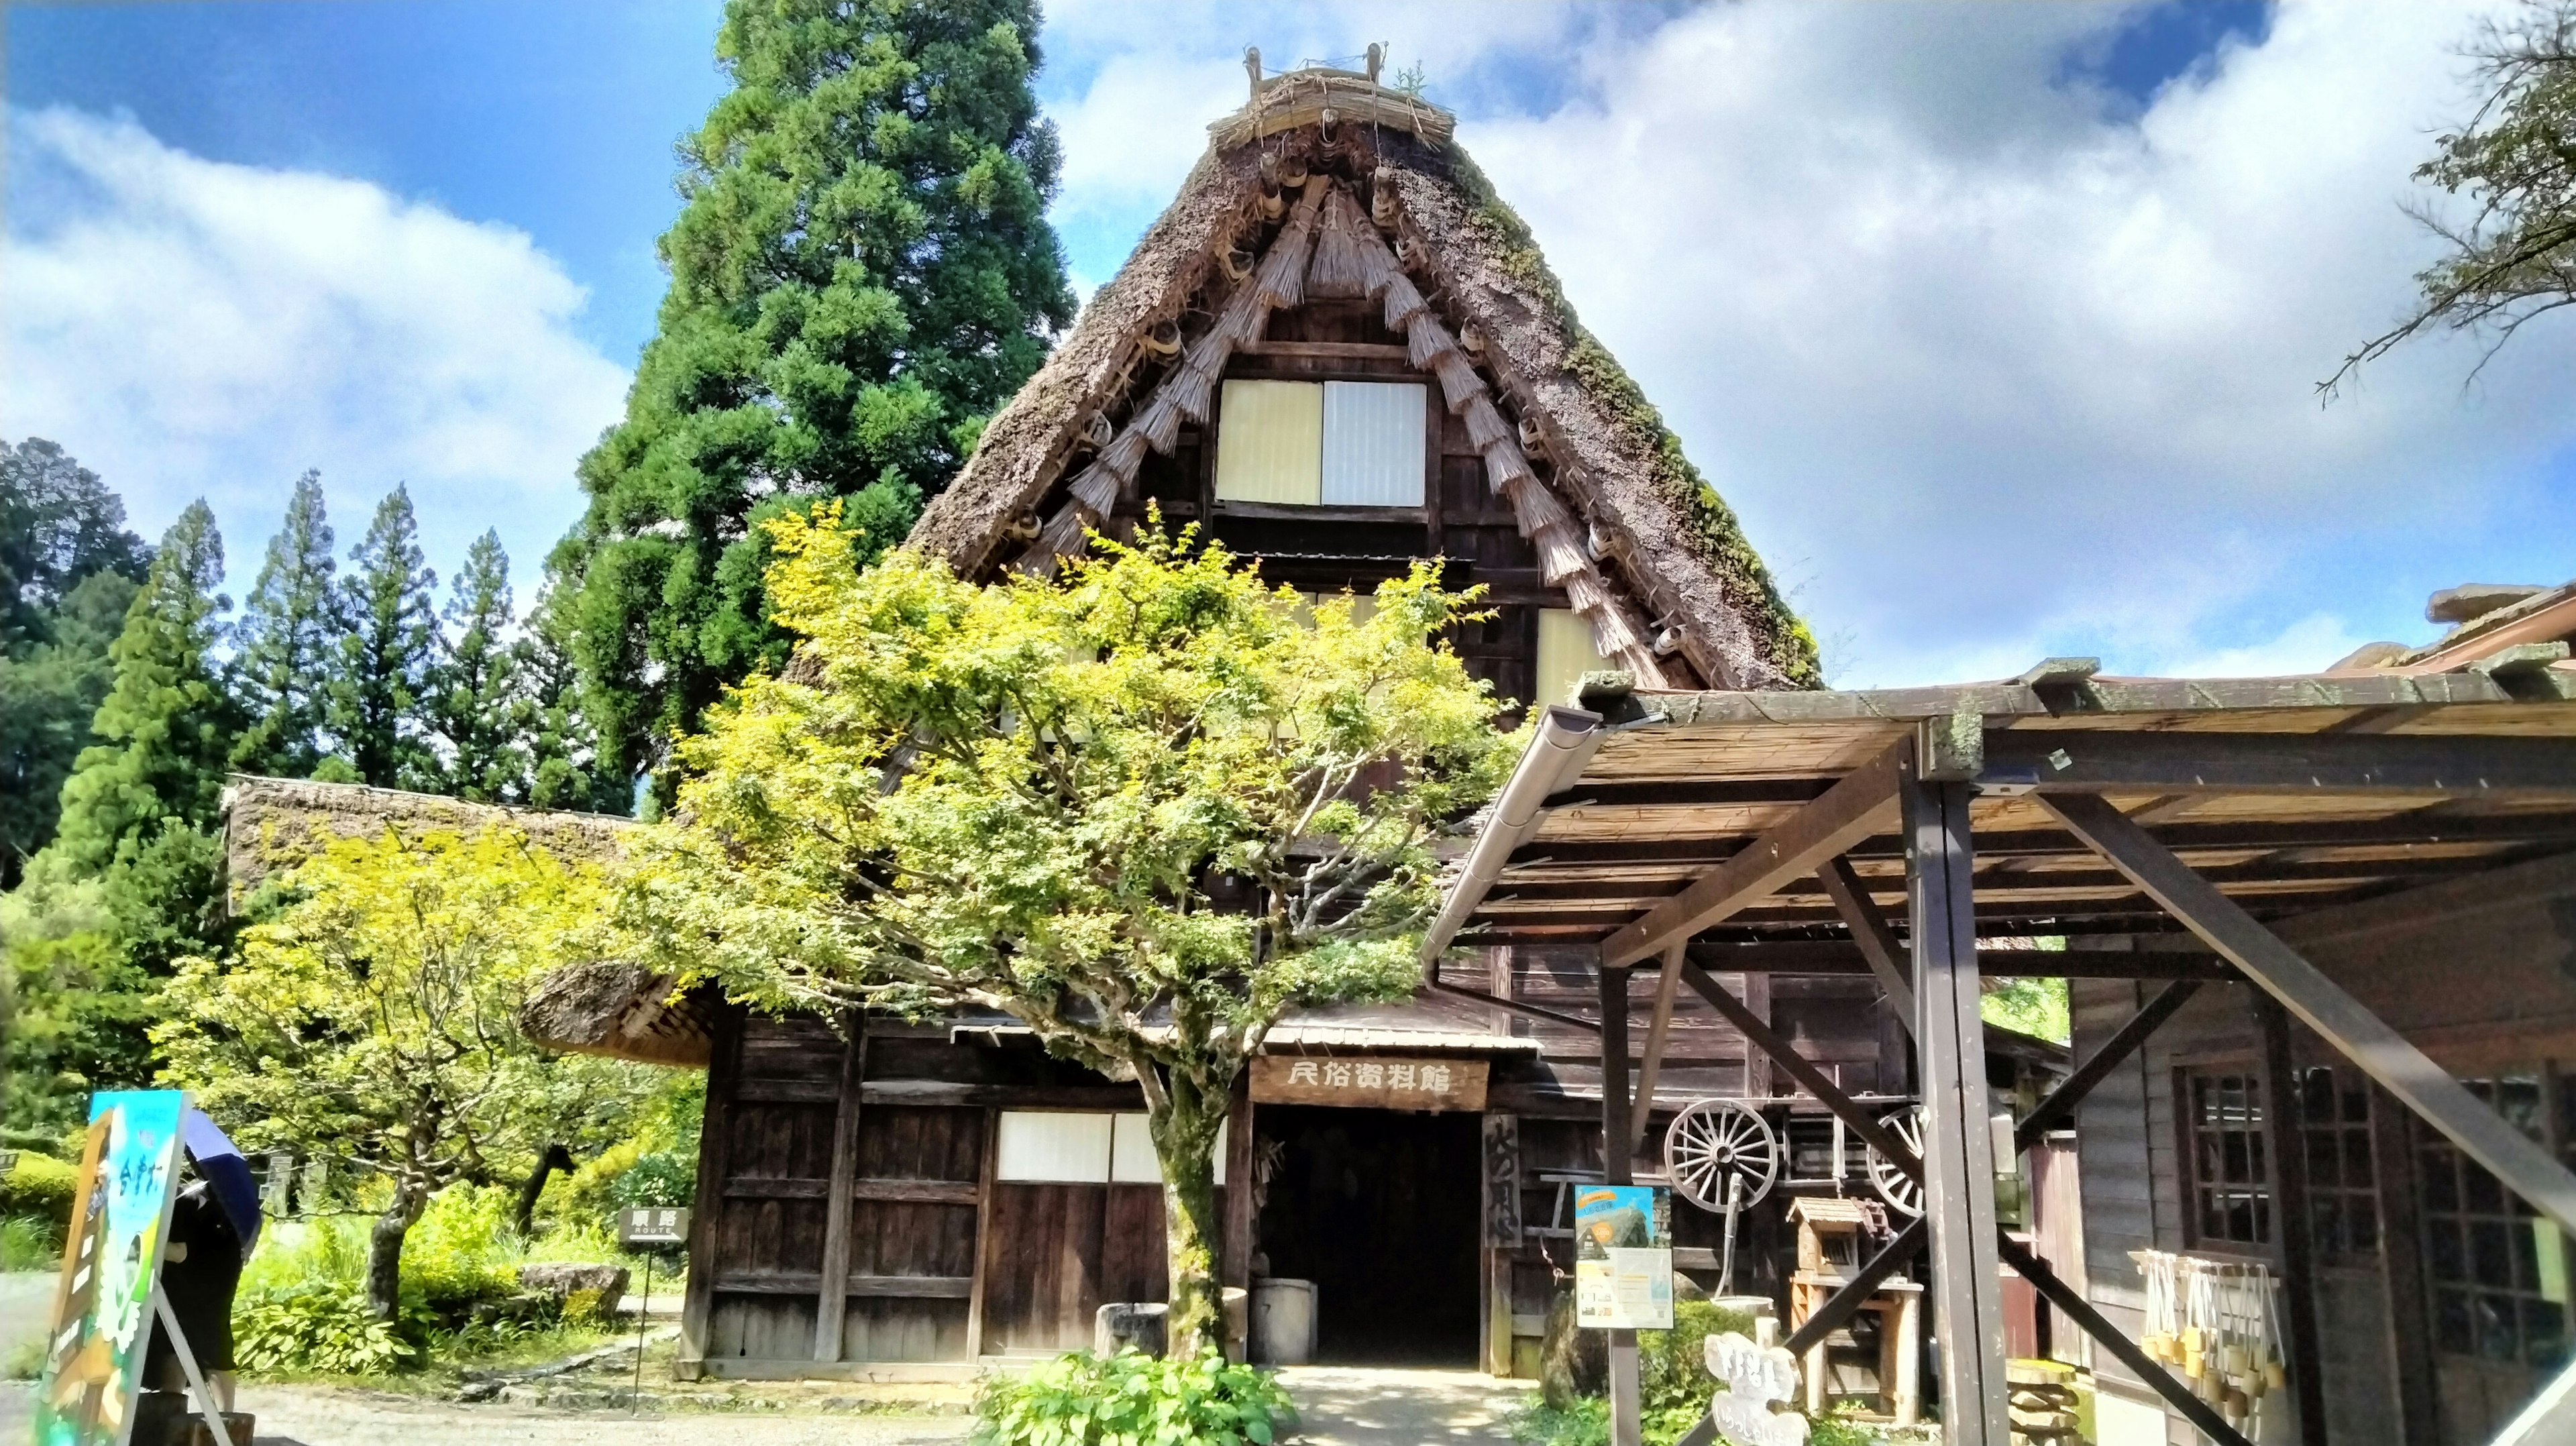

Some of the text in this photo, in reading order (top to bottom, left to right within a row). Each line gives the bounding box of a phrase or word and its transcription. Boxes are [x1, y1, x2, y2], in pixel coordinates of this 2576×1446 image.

[1287, 1060, 1451, 1092] 民俗資料館
[1485, 1122, 1519, 1241] 火の用心
[631, 1210, 677, 1227] 順路
